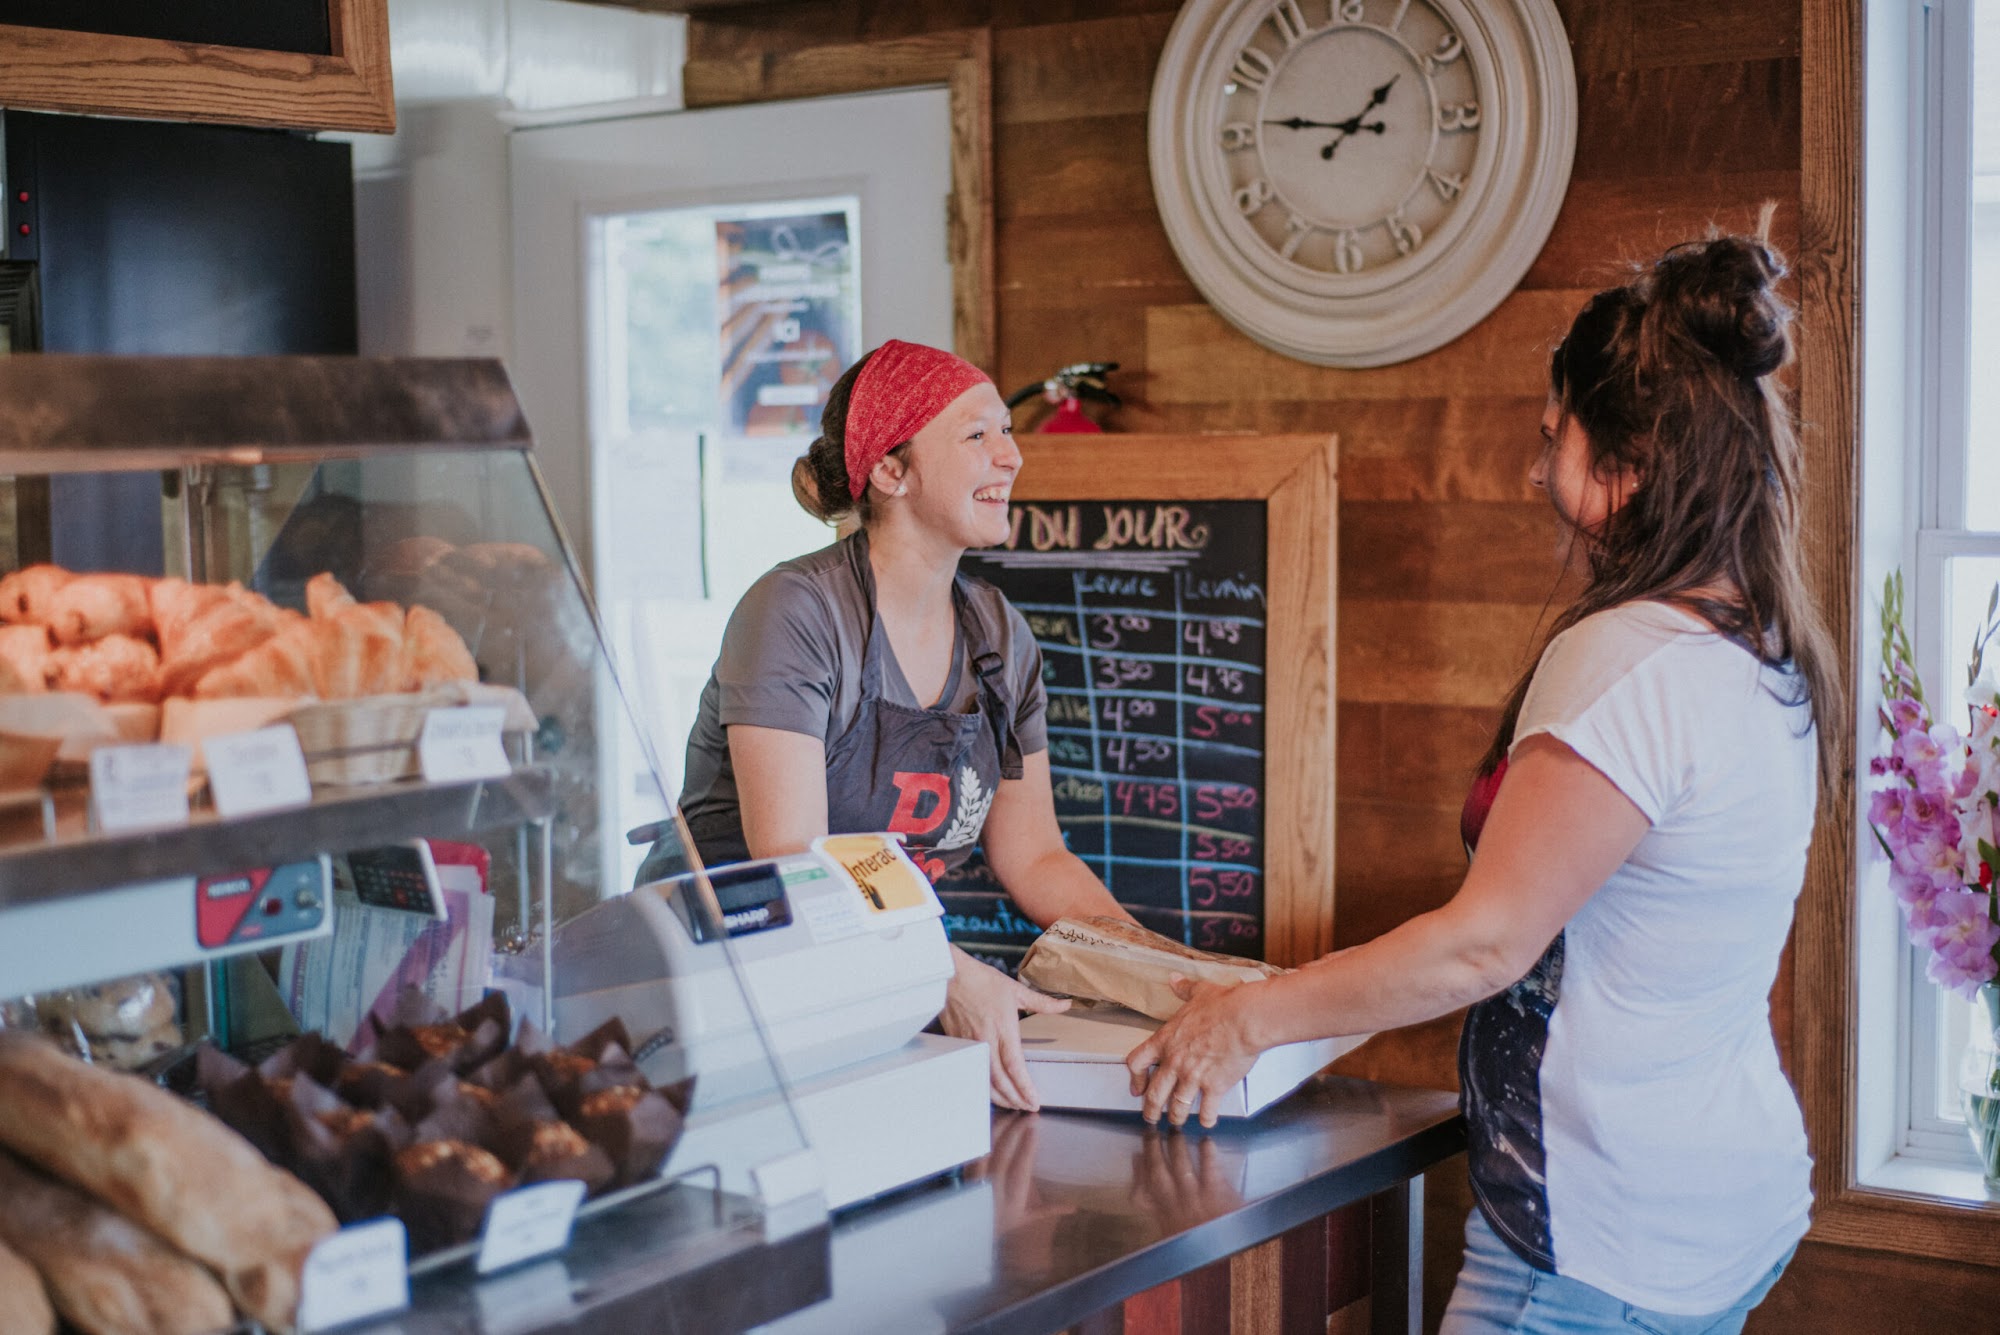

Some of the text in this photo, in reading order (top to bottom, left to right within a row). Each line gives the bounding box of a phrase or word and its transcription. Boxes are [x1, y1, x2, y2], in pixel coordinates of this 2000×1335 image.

[1438, 102, 1480, 131] 3
[1427, 167, 1468, 201] 4
[1335, 229, 1364, 274] 6
[1026, 505, 1081, 550] DU
[1094, 505, 1208, 549] JOUR
[842, 847, 897, 883] Interac
